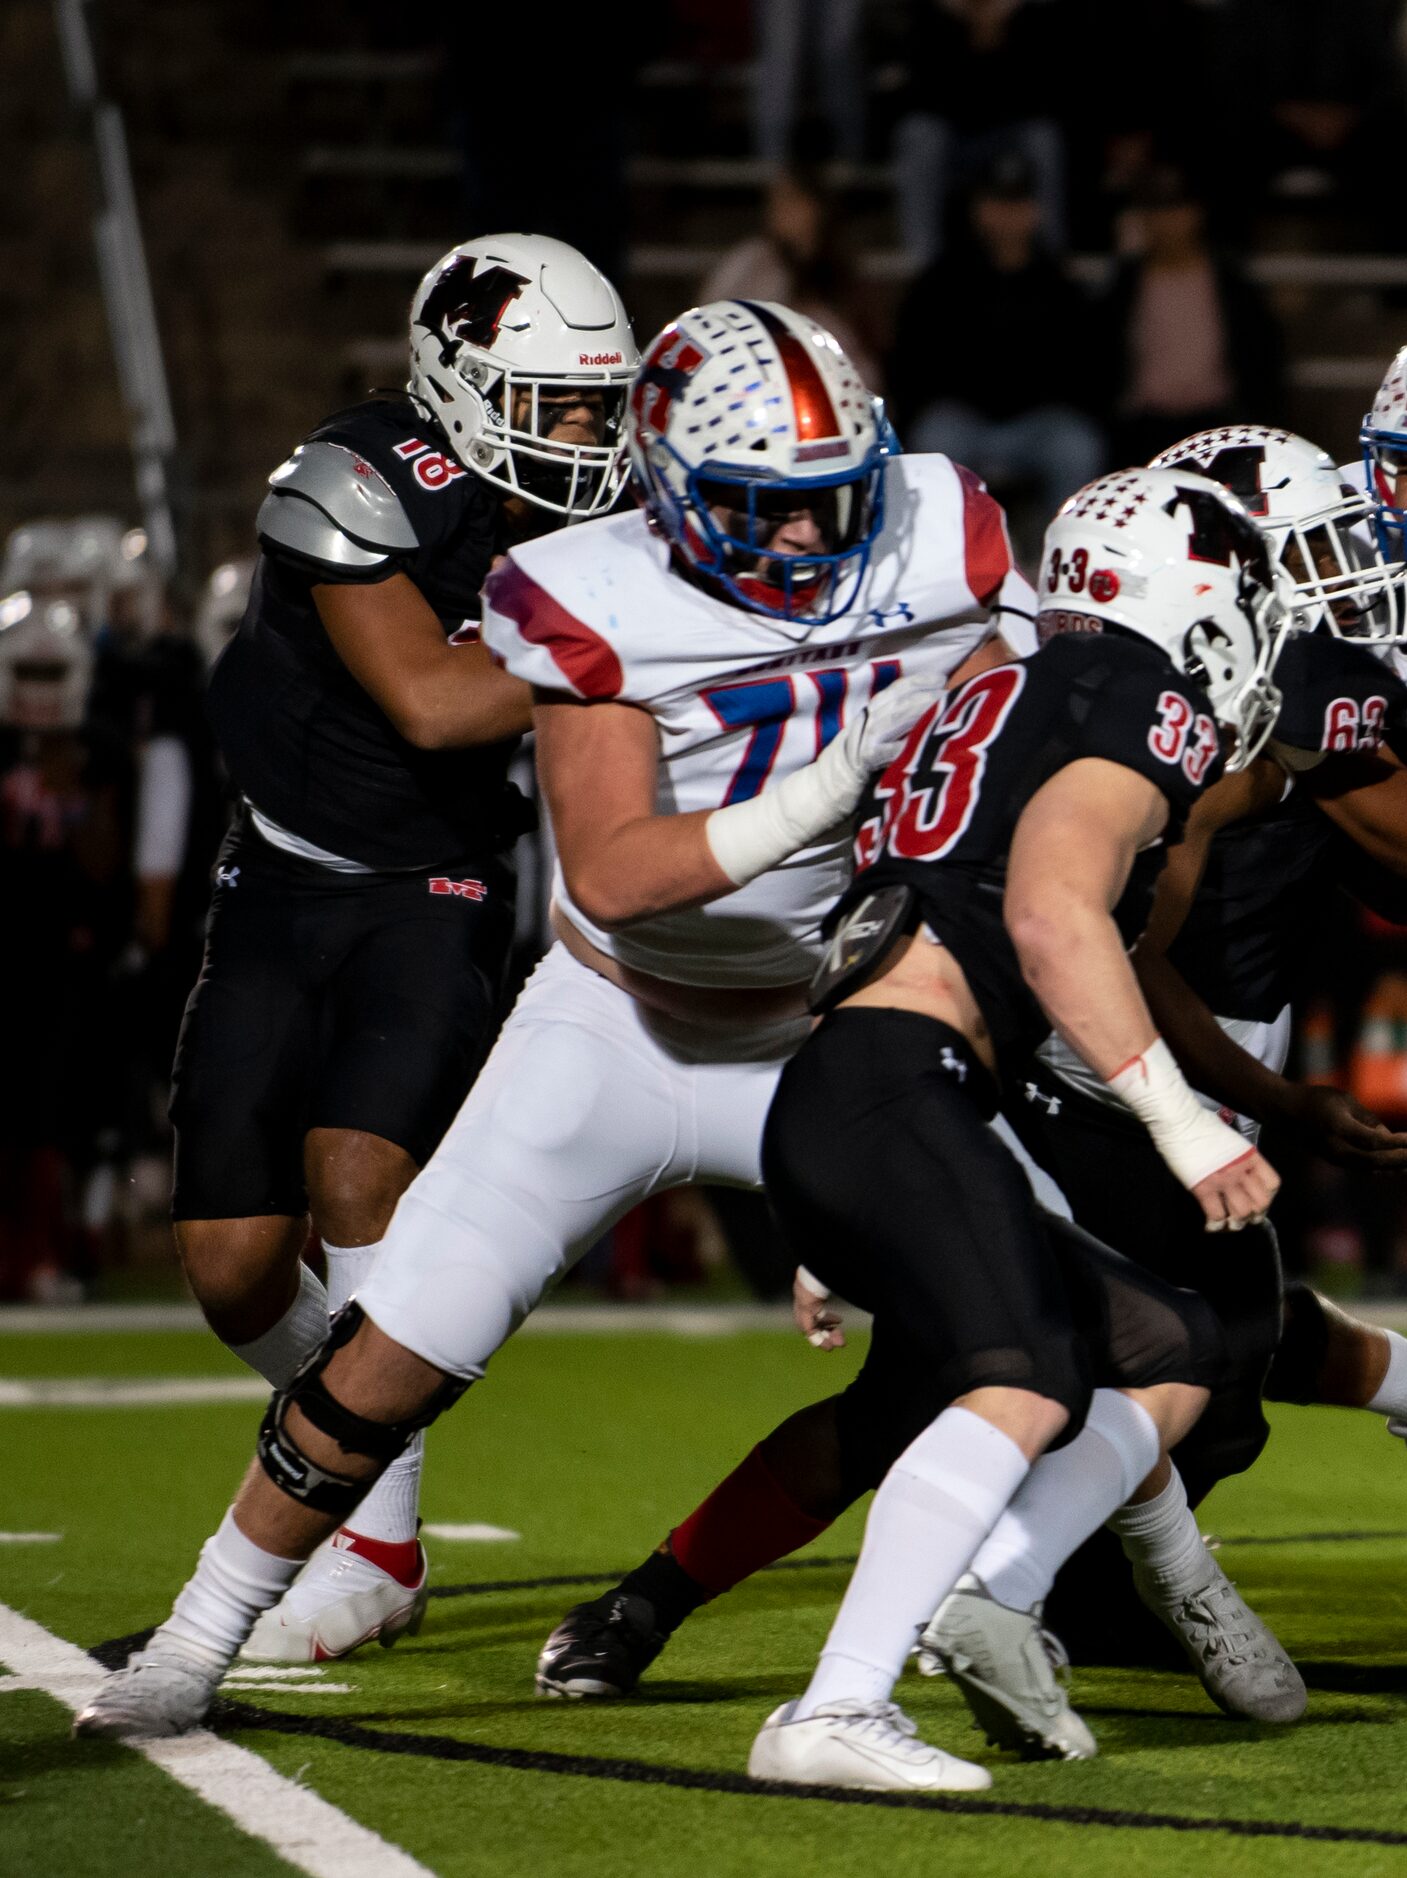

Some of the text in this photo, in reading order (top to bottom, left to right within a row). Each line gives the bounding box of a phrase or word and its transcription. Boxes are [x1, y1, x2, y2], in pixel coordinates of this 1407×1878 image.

[579, 351, 622, 366] Riddell
[392, 437, 468, 492] 18
[1147, 690, 1219, 786] 33
[1320, 695, 1389, 754] 63
[853, 663, 1027, 877] 33
